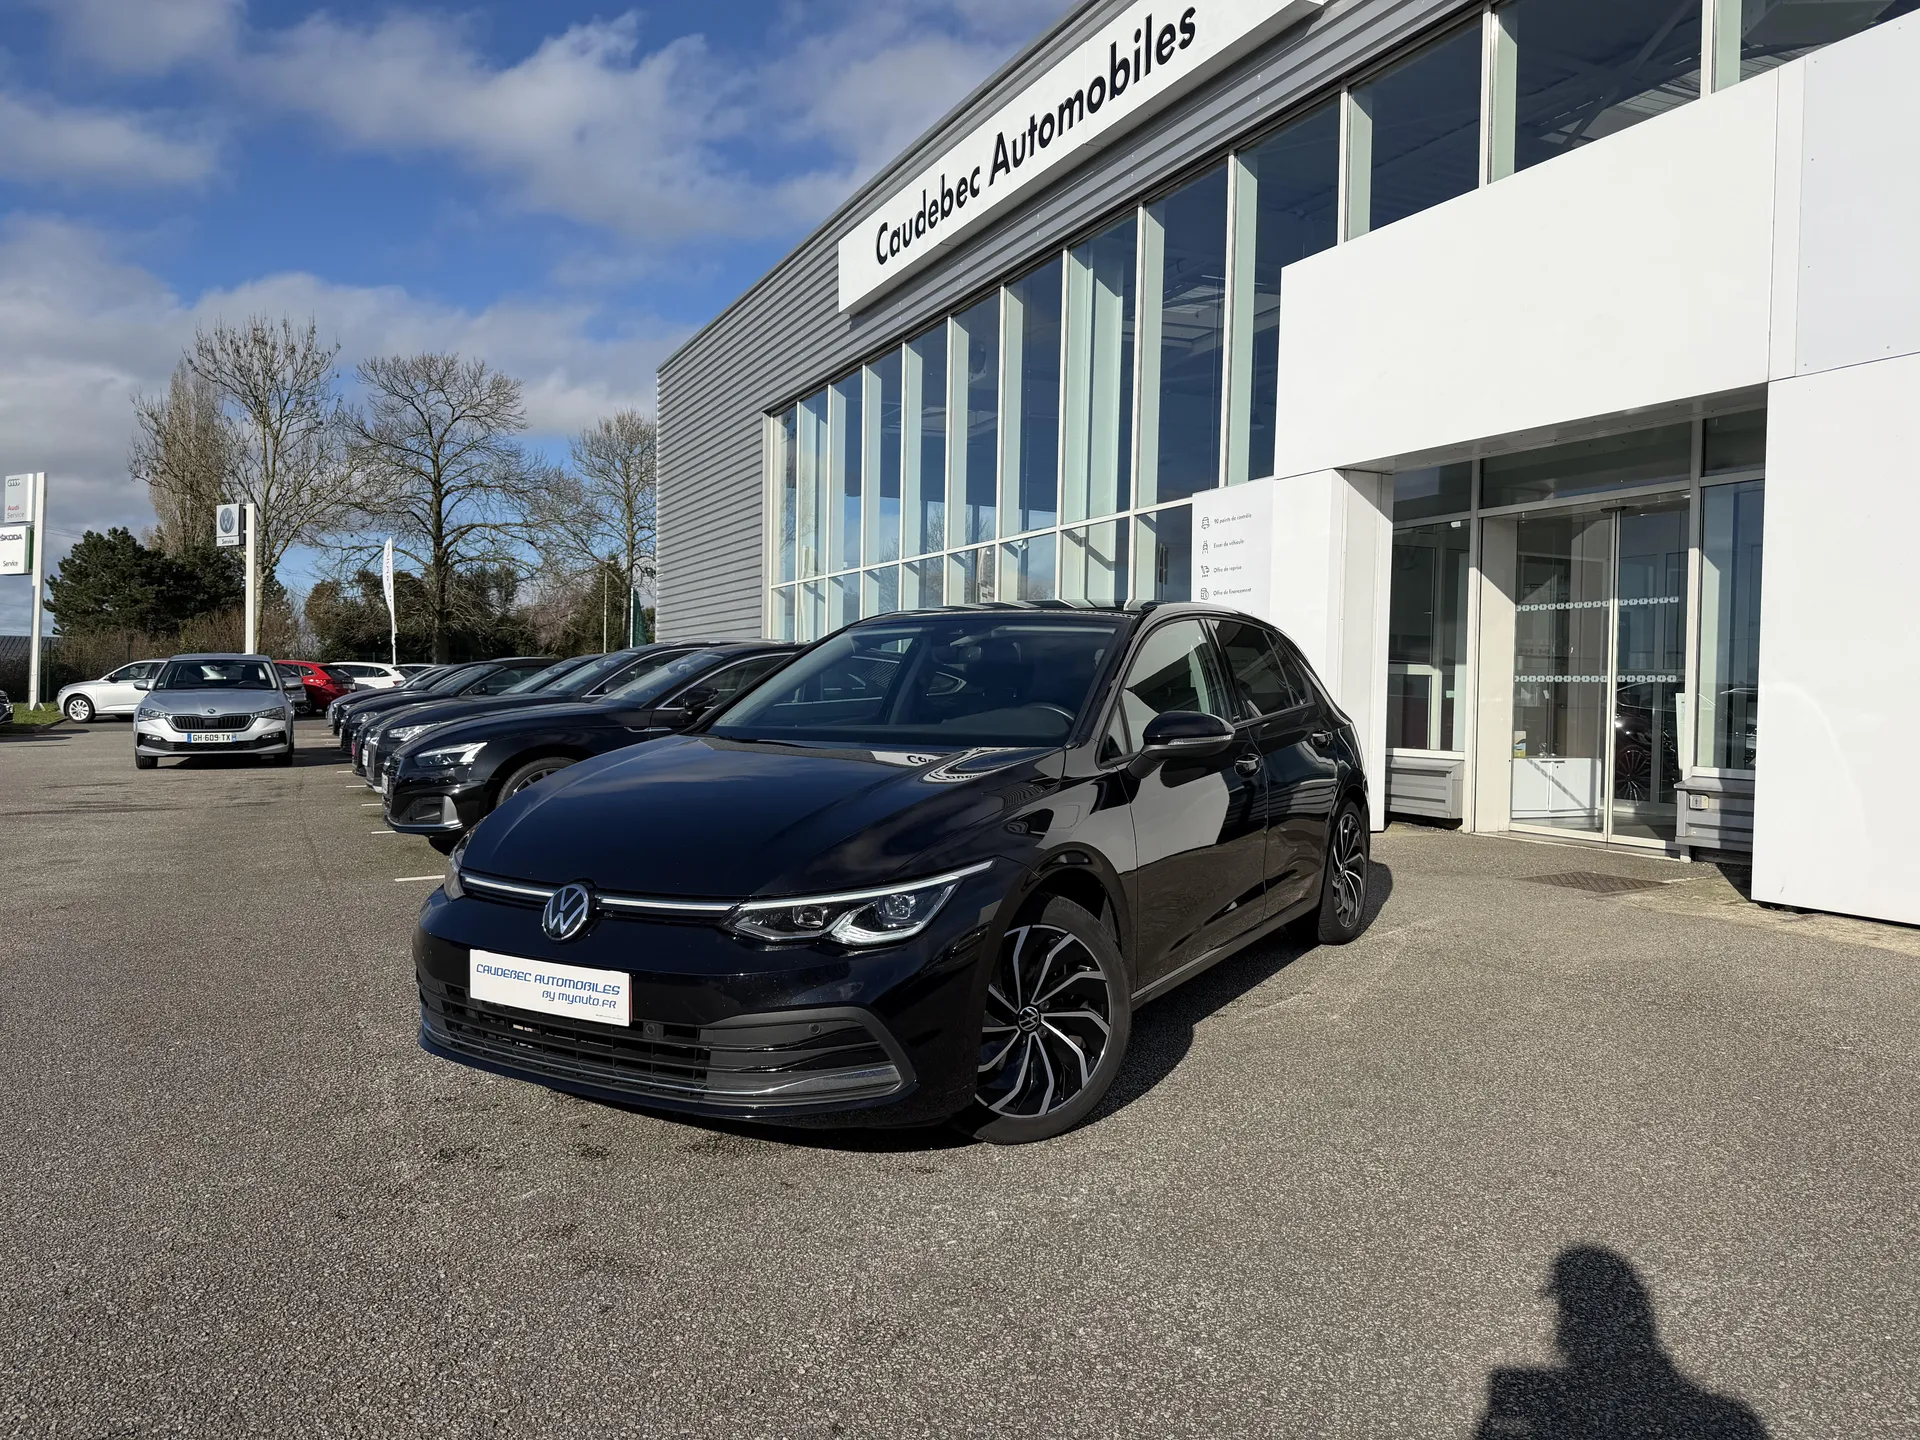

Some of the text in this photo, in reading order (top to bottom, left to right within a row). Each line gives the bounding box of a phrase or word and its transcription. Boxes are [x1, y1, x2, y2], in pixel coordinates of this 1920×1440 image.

[875, 5, 1196, 266] Caudebec Automobiles
[476, 963, 620, 995] CAUDEBEC AUTOMOBILES
